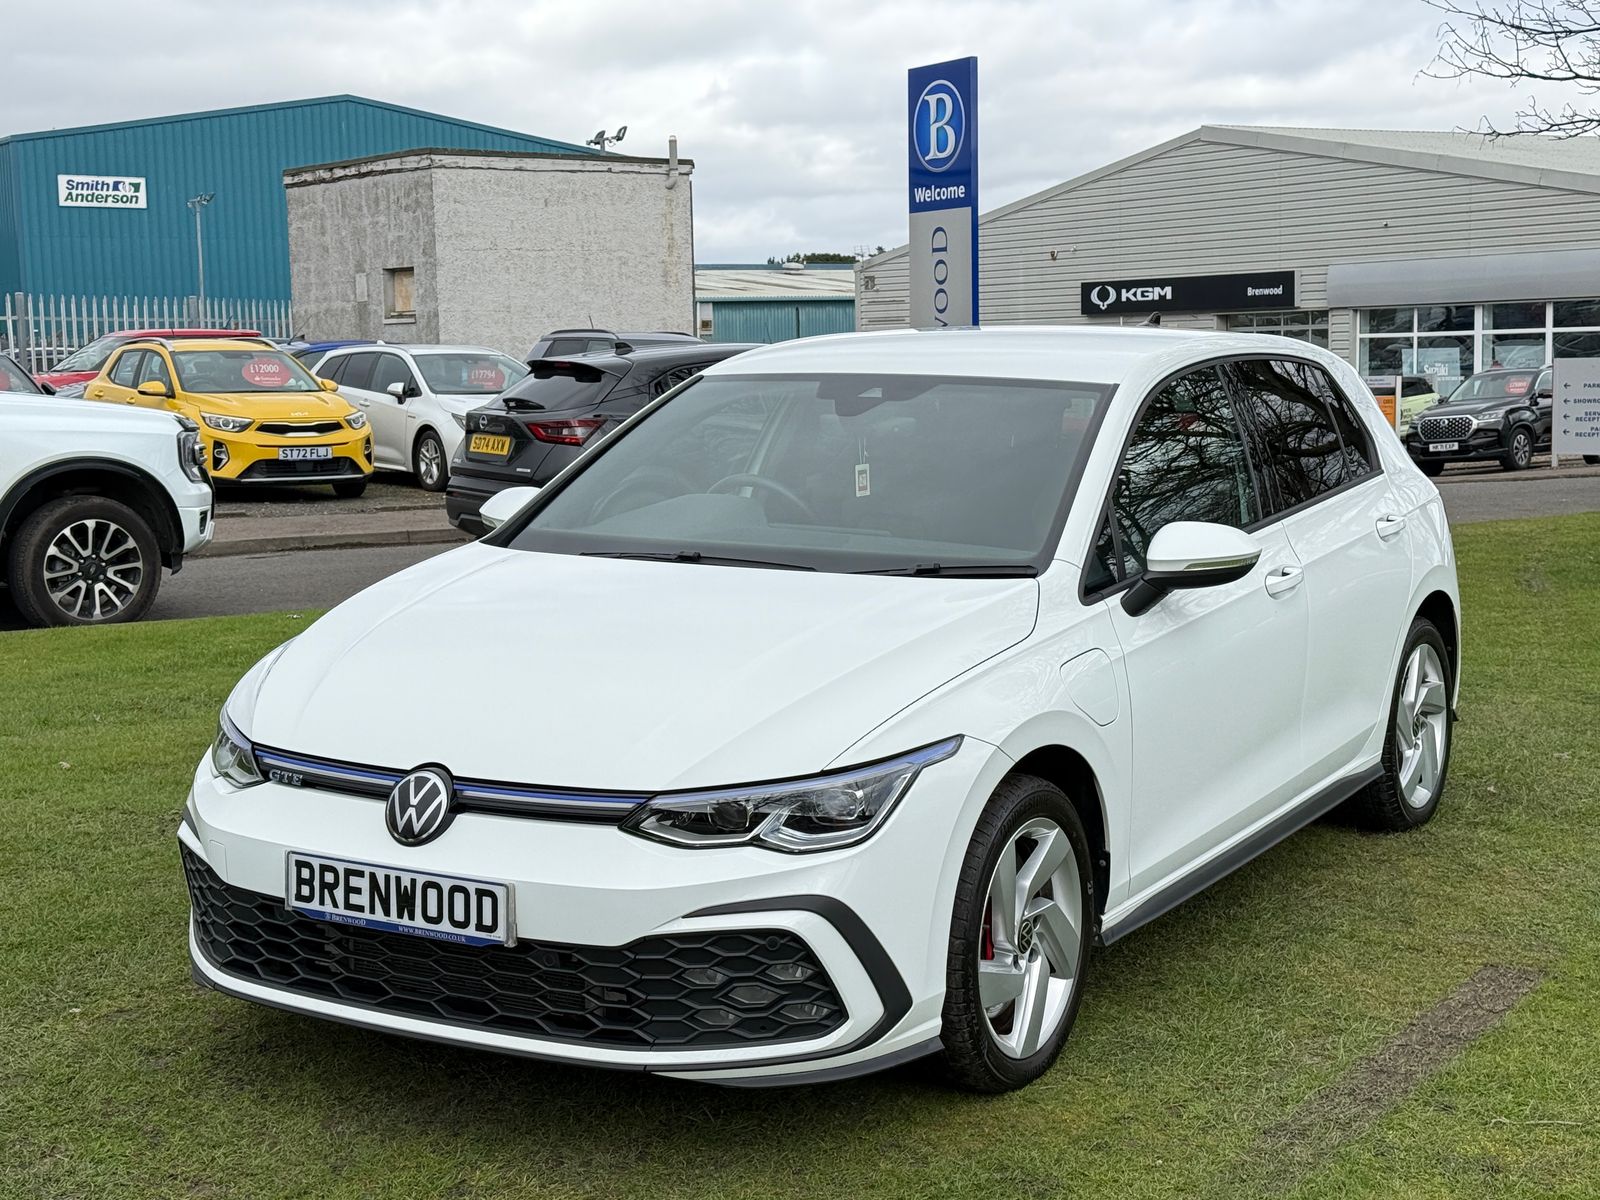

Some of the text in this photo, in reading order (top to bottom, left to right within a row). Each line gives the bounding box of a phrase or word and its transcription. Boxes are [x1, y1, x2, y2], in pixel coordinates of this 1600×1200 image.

[65, 179, 110, 192] Smith
[64, 191, 139, 204] Anderson
[914, 184, 966, 203] Welcome
[1121, 286, 1172, 302] KGM
[1247, 284, 1283, 297] Brenwood
[250, 363, 279, 373] £12000
[1423, 363, 1449, 376] Suzuki
[281, 447, 329, 459] ST72 FLJ
[269, 768, 304, 787] GTE
[294, 859, 499, 934] BRENWOOD
[398, 925, 467, 944] WWW.BRENWOOD.CO.UK
